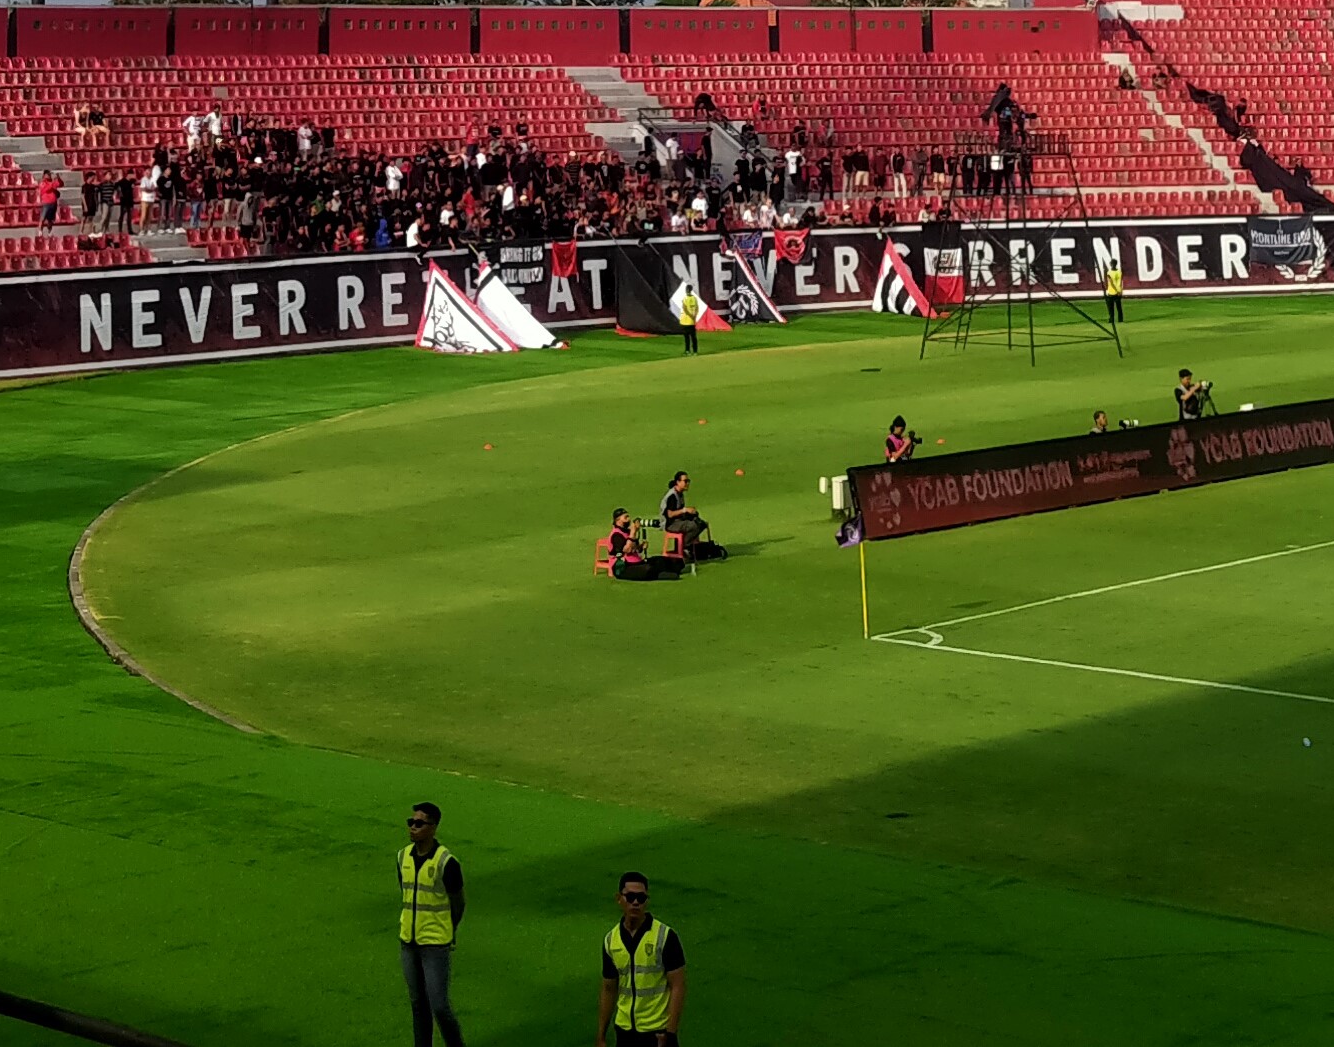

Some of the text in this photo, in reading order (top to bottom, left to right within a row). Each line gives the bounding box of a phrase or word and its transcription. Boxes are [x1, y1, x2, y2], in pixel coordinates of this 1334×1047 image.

[79, 279, 309, 353] NEVER
[338, 259, 608, 330] REAT
[892, 234, 1251, 290] RRENDER
[1200, 432, 1243, 464] YCAB
[1243, 417, 1334, 457] FOUNDATION
[907, 477, 960, 511] YCAB
[962, 461, 1073, 501] FOUNDATION
